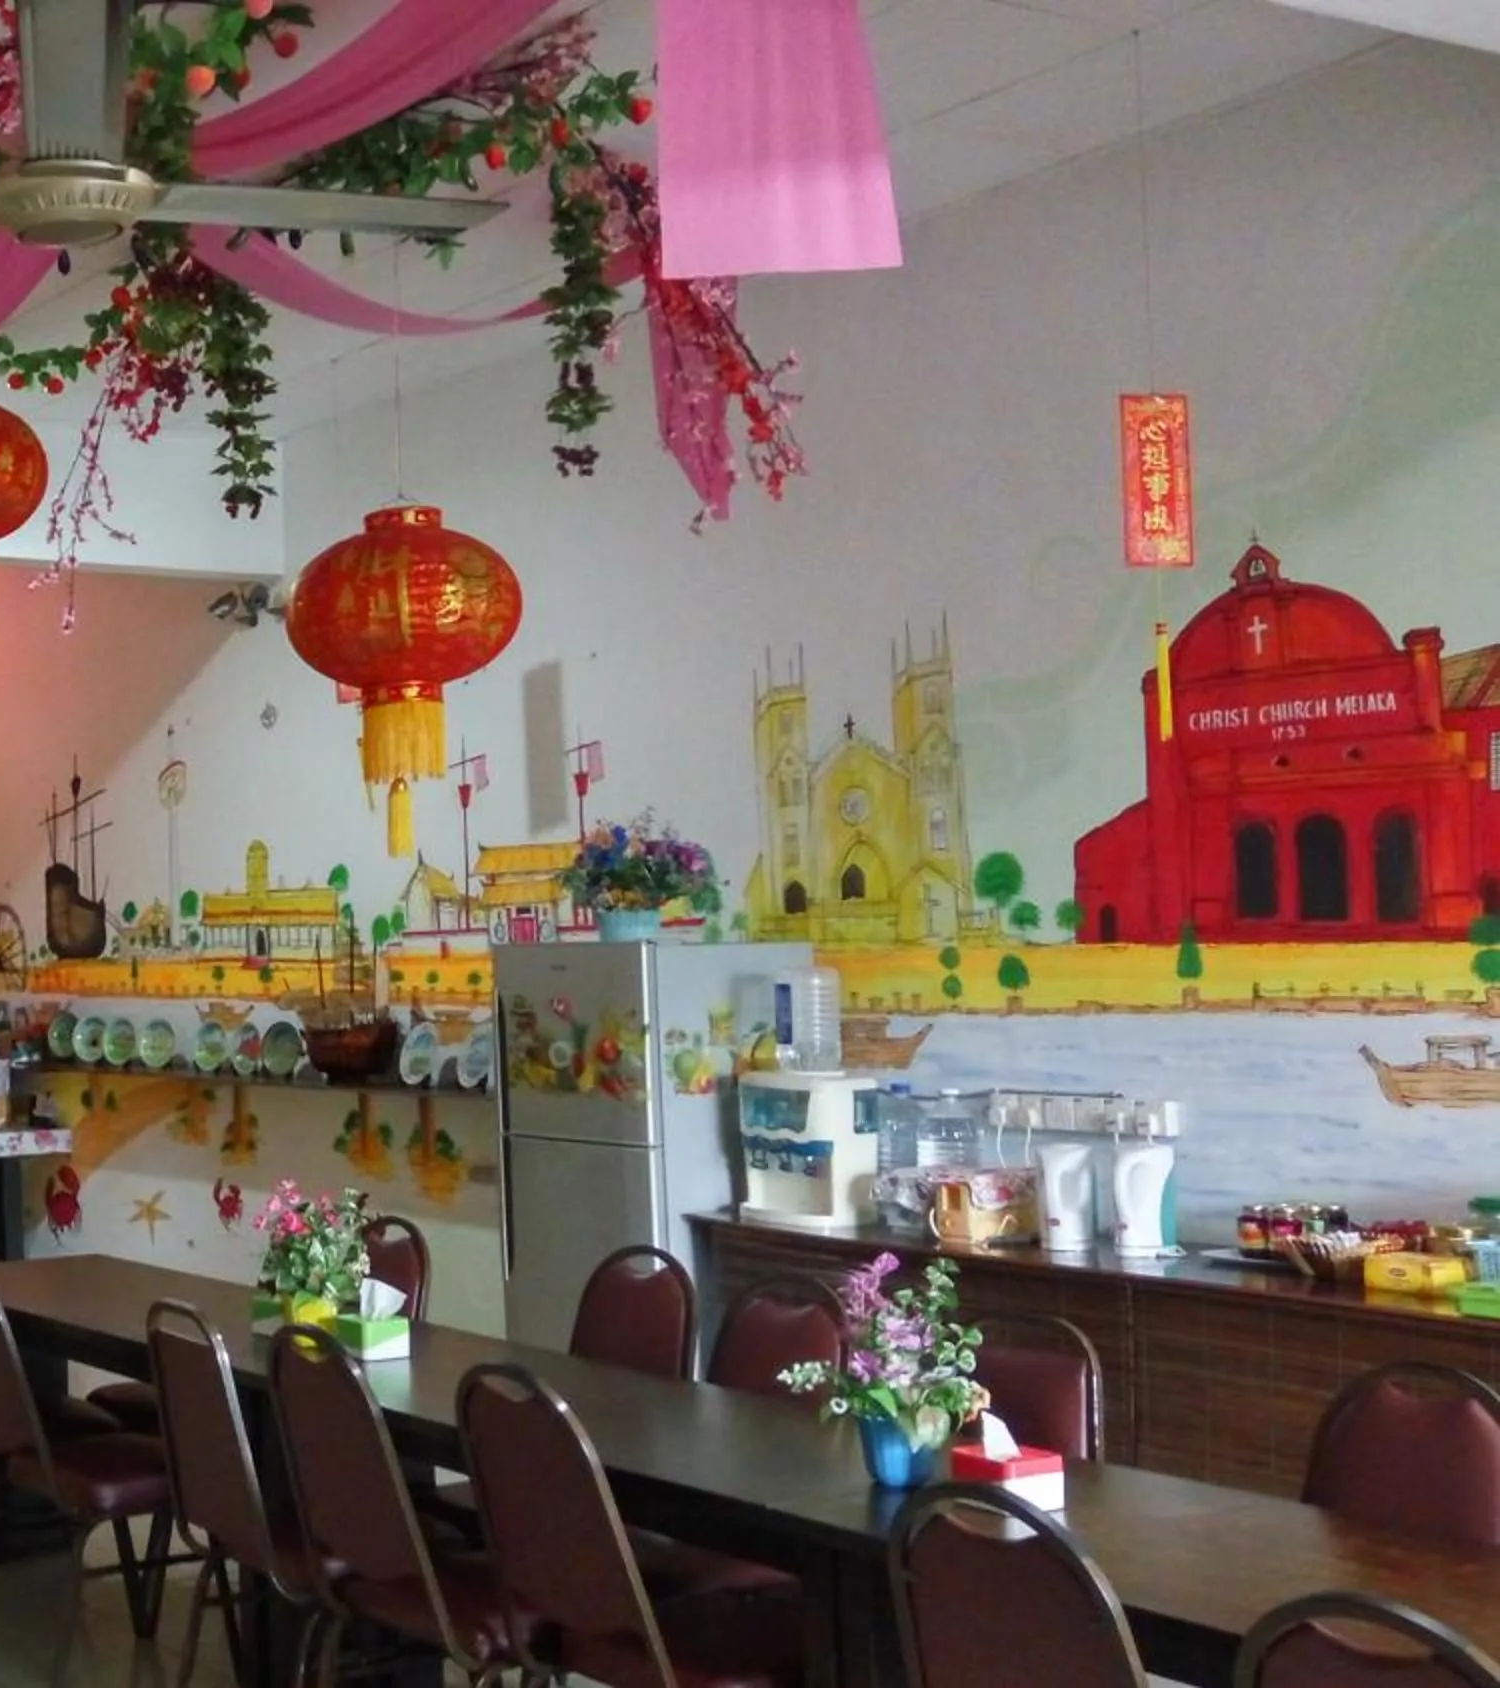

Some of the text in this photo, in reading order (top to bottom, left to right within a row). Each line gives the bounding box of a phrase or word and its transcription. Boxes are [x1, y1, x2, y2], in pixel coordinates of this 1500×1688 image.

[1188, 691, 1398, 732] CHRIST CHURCH MELAKA
